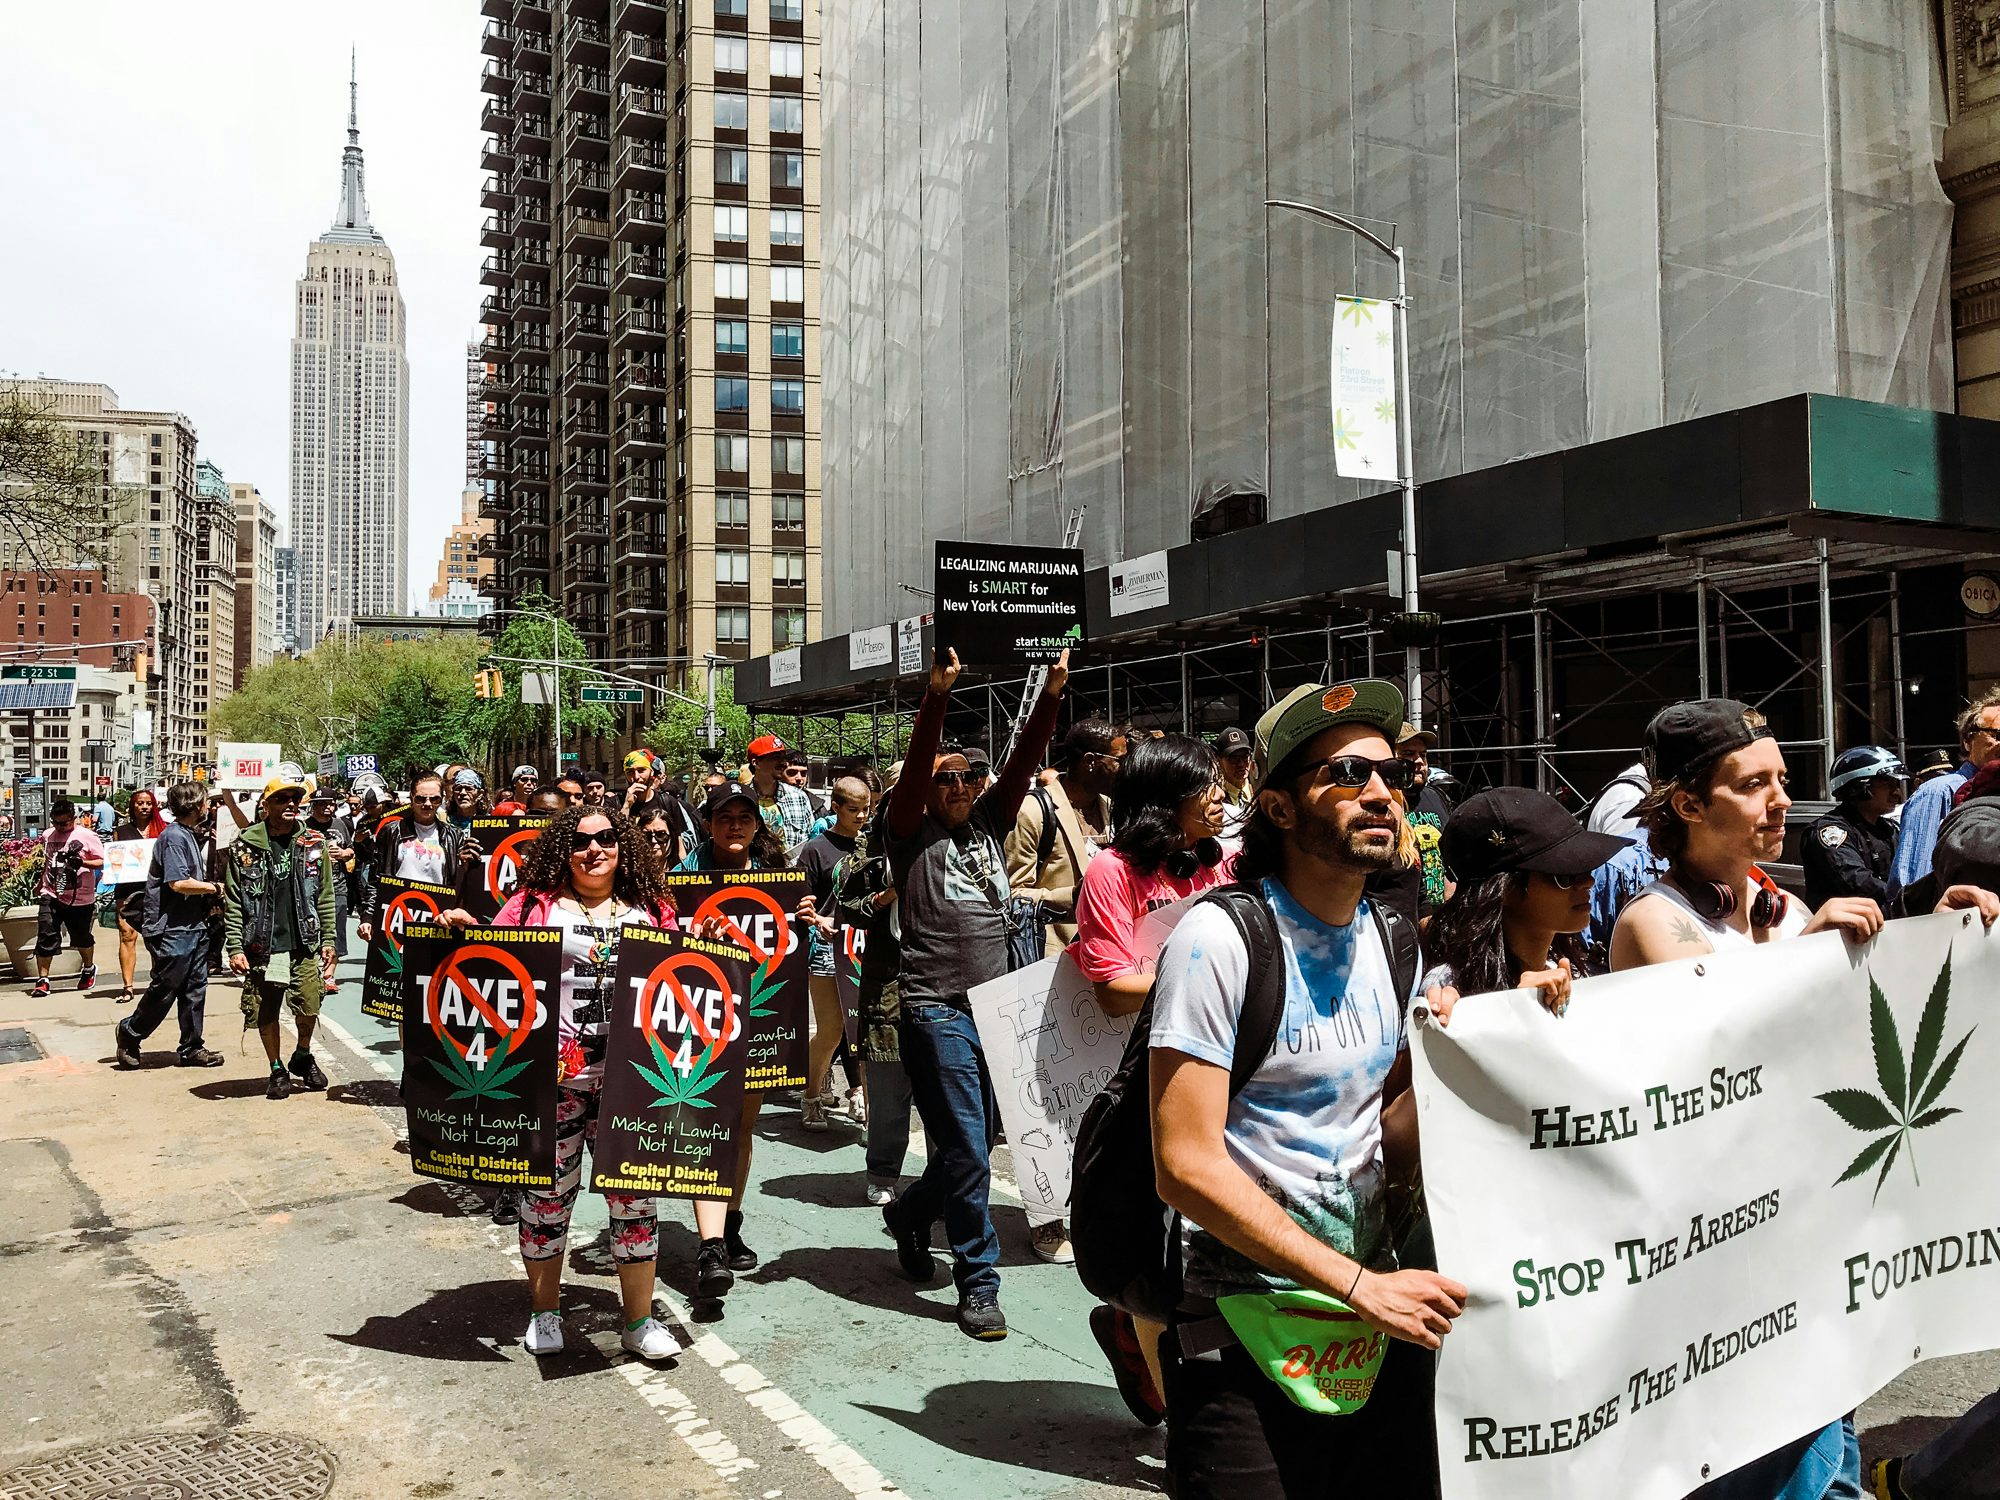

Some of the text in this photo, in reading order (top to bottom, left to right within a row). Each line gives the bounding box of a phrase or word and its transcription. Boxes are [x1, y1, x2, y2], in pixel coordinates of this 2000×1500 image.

[940, 557, 1079, 576] LEGALIZING MARIJUANA
[969, 580, 1049, 595] is SMART for
[943, 598, 1076, 614] New York Communities
[1015, 637, 1076, 647] start SMART
[21, 668, 58, 678] E 22 St
[597, 691, 627, 700] E 22 St
[238, 761, 261, 776] EXIT
[351, 755, 376, 771] 338
[472, 818, 510, 828] REPEAL
[380, 876, 456, 896] REPEAL PROHIBITION
[667, 872, 806, 886] REPEAL PROHIBITION
[406, 926, 561, 943] REPEAL PROHIBITION
[623, 927, 750, 963] REPEAL PROHIBITION
[369, 975, 390, 987] Make
[379, 987, 393, 998] Not
[362, 1004, 390, 1018] Cannabis
[371, 999, 395, 1012] Capital
[416, 975, 548, 1030] TAXES
[629, 976, 742, 1042] TAXES
[1330, 991, 1366, 1049] ON
[748, 1026, 796, 1043] awful
[465, 1032, 488, 1072] 4
[671, 1039, 693, 1079] 4
[746, 1043, 778, 1063] egal
[744, 1075, 806, 1090] onsortium
[1529, 1064, 1763, 1150] HEAL THE SICK
[417, 1107, 541, 1131] Make It Lawful
[611, 1115, 730, 1141] Make It Lawful
[441, 1126, 519, 1154] Not Legal
[638, 1135, 712, 1163] Not Legal
[429, 1150, 530, 1171] Capital District
[414, 1158, 552, 1185] Cannabis Consortium
[620, 1161, 719, 1182] Capital District
[595, 1174, 733, 1197] Cannabis Consortium
[1512, 1188, 1780, 1309] STOP THE ARRESTS
[1315, 1377, 1332, 1388] TO
[1335, 1378, 1363, 1390] KEEP
[1463, 1301, 1797, 1463] RELEASE THE MEDICINE
[1319, 1388, 1342, 1400] OFF
